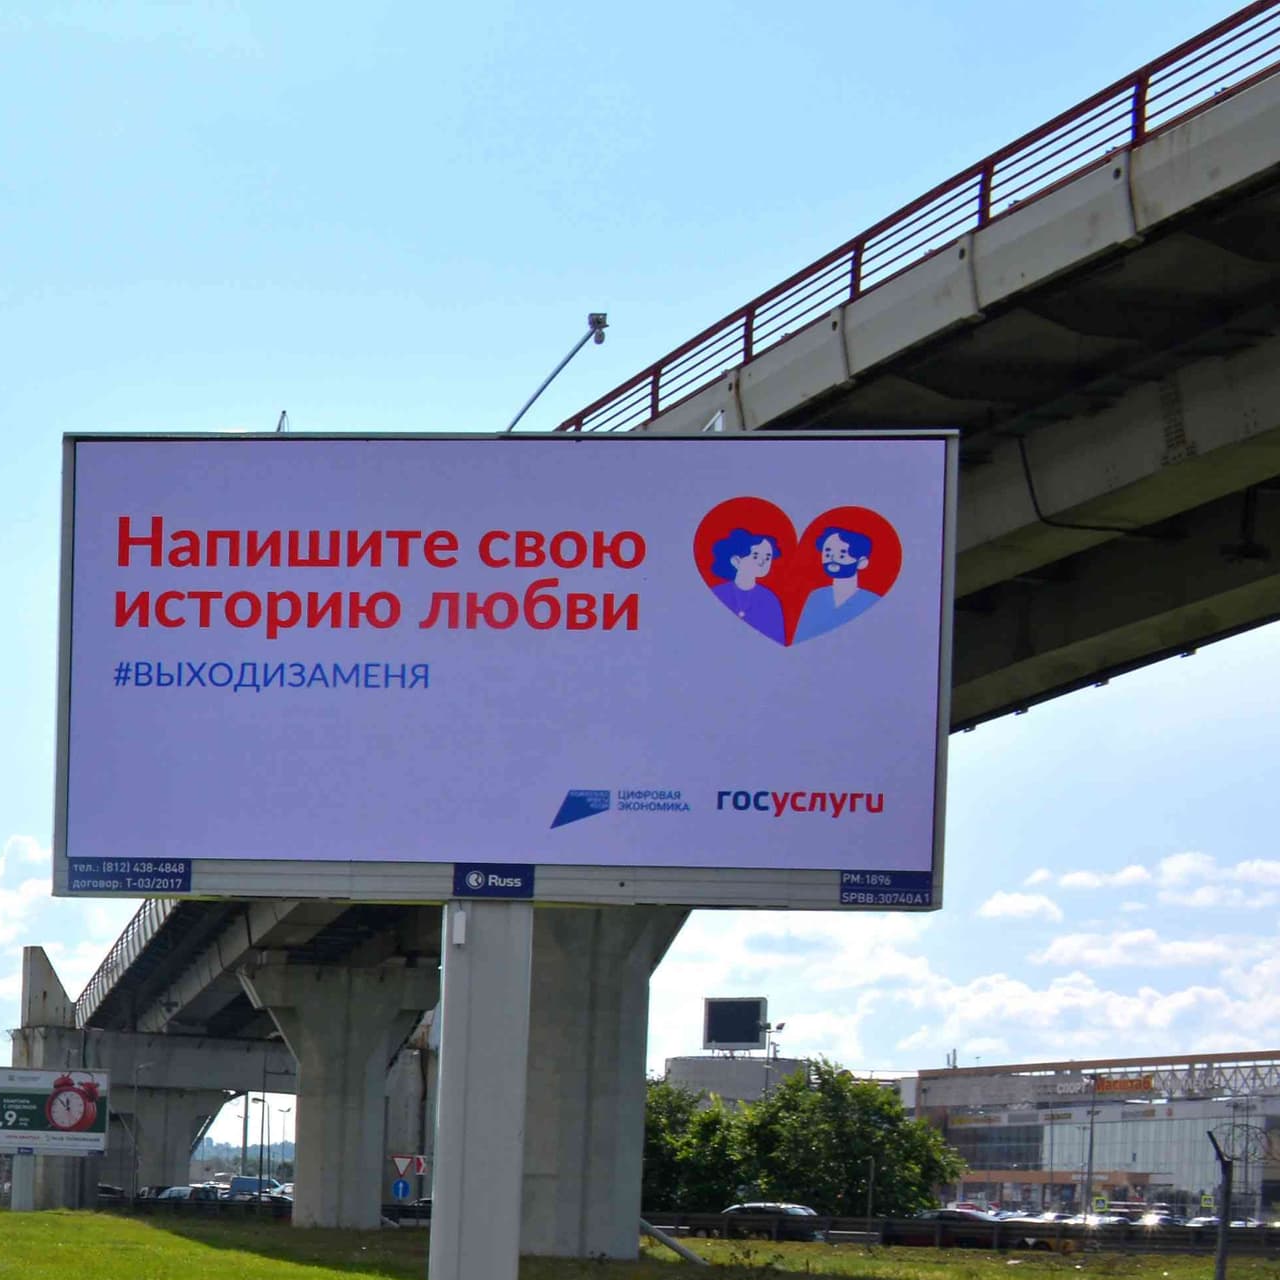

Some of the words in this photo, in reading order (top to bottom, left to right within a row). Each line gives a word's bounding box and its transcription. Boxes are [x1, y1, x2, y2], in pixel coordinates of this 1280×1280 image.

[118, 516, 458, 568] Напишите
[479, 530, 647, 569] свою
[114, 590, 401, 640] историю
[418, 577, 639, 631] любви
[114, 661, 429, 693] #ВЫХОДИЗАМЕНЯ
[617, 790, 681, 800] ЦИФРОВАЯ
[716, 790, 884, 818] госуслуги
[617, 801, 690, 812] ЭКОНОМИКА
[102, 862, 130, 873] (812)
[133, 862, 185, 873] 438-4848
[488, 874, 522, 887] Russ
